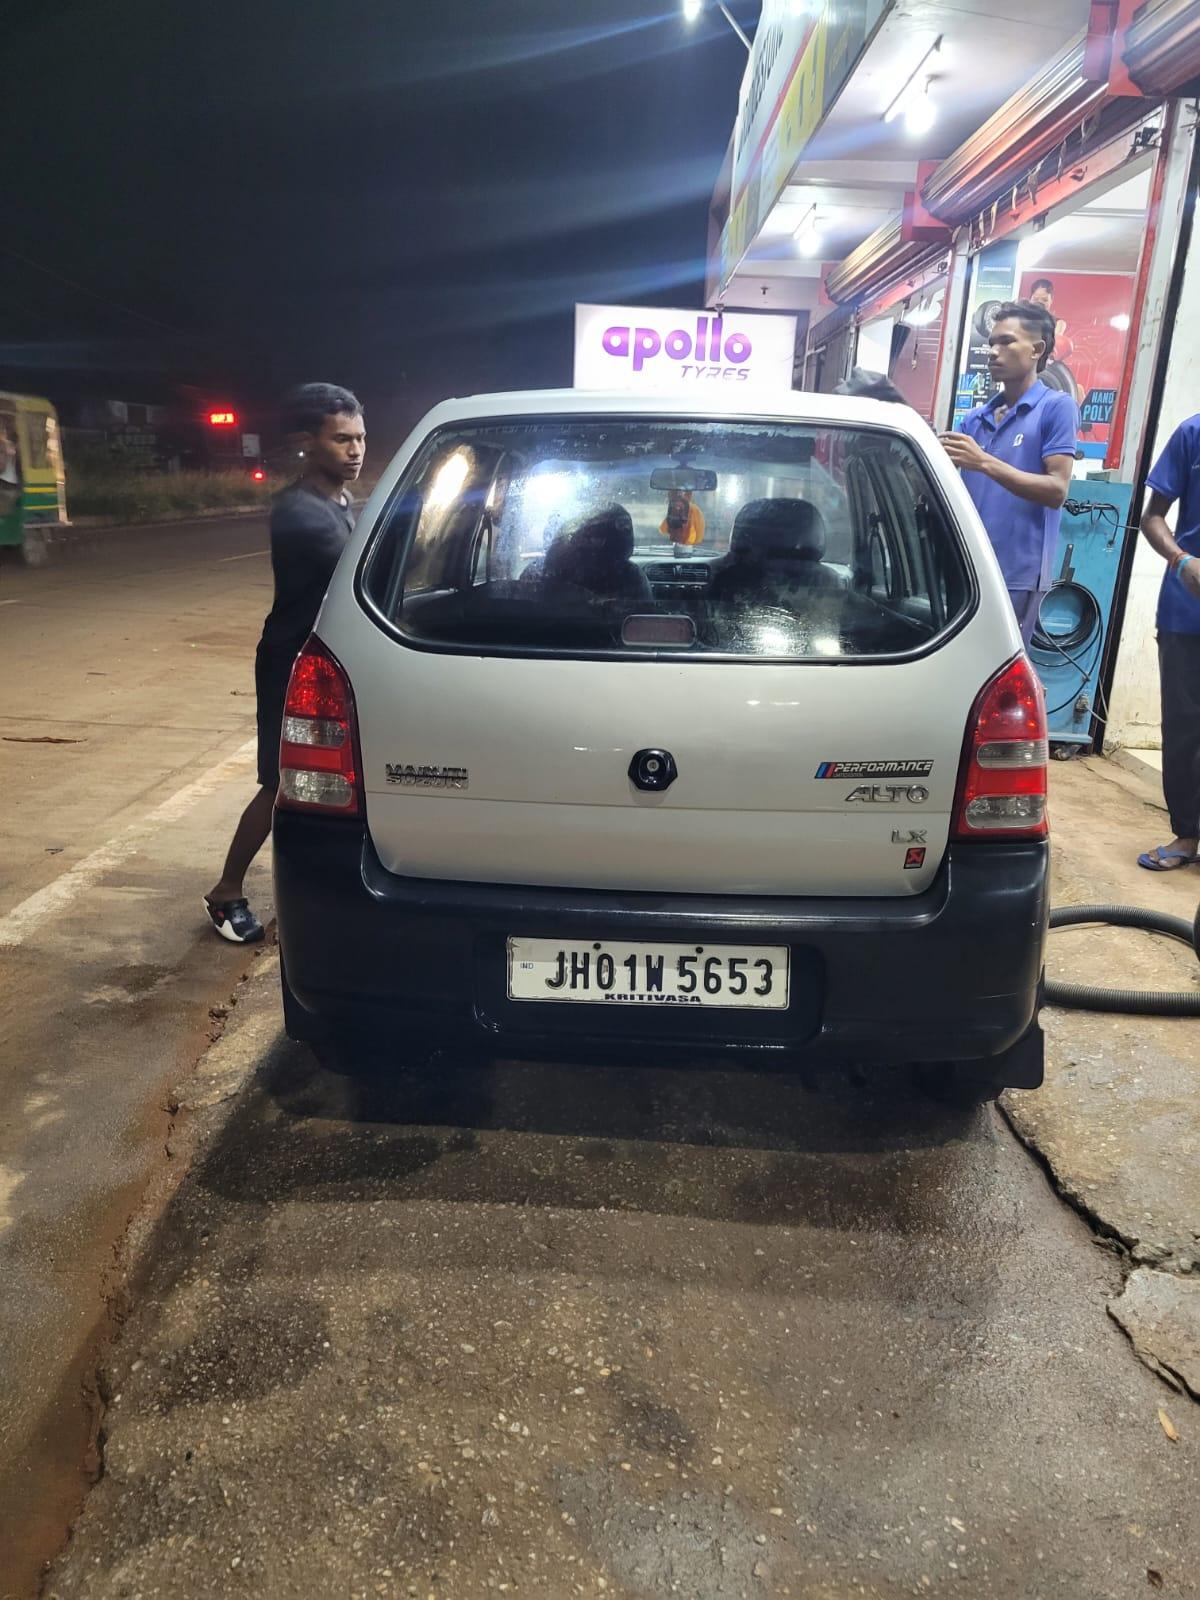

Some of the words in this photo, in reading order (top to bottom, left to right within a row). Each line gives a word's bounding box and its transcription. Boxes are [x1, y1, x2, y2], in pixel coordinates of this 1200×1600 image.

[602, 316, 752, 372] apollo
[681, 365, 751, 381] TYRES
[1083, 404, 1113, 422] POLY
[834, 762, 933, 772] PERFORMANCE
[845, 784, 930, 803] ALTO
[604, 993, 702, 1003] KRITIVASA
